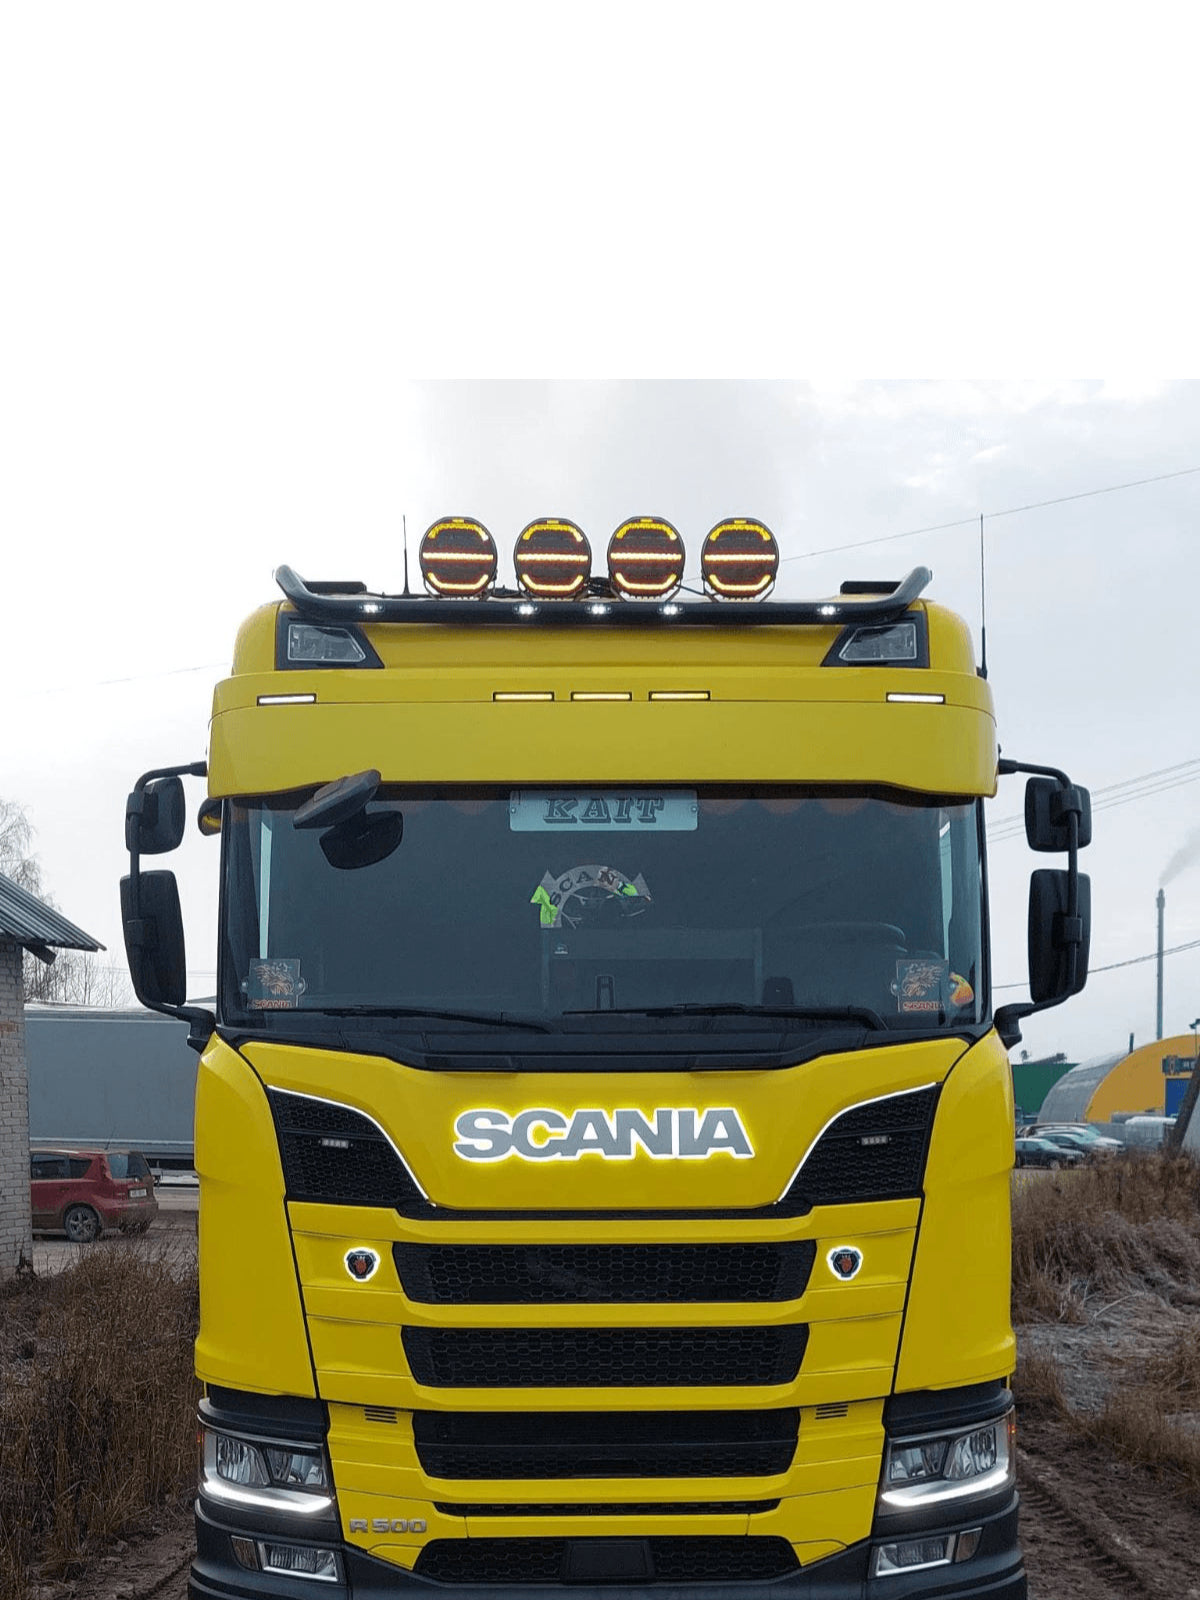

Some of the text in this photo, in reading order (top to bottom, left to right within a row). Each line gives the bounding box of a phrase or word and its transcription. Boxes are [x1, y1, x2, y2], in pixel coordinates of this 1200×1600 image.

[543, 798, 665, 824] KAIT
[453, 1108, 755, 1162] SCANIA
[350, 1518, 427, 1533] R 500
